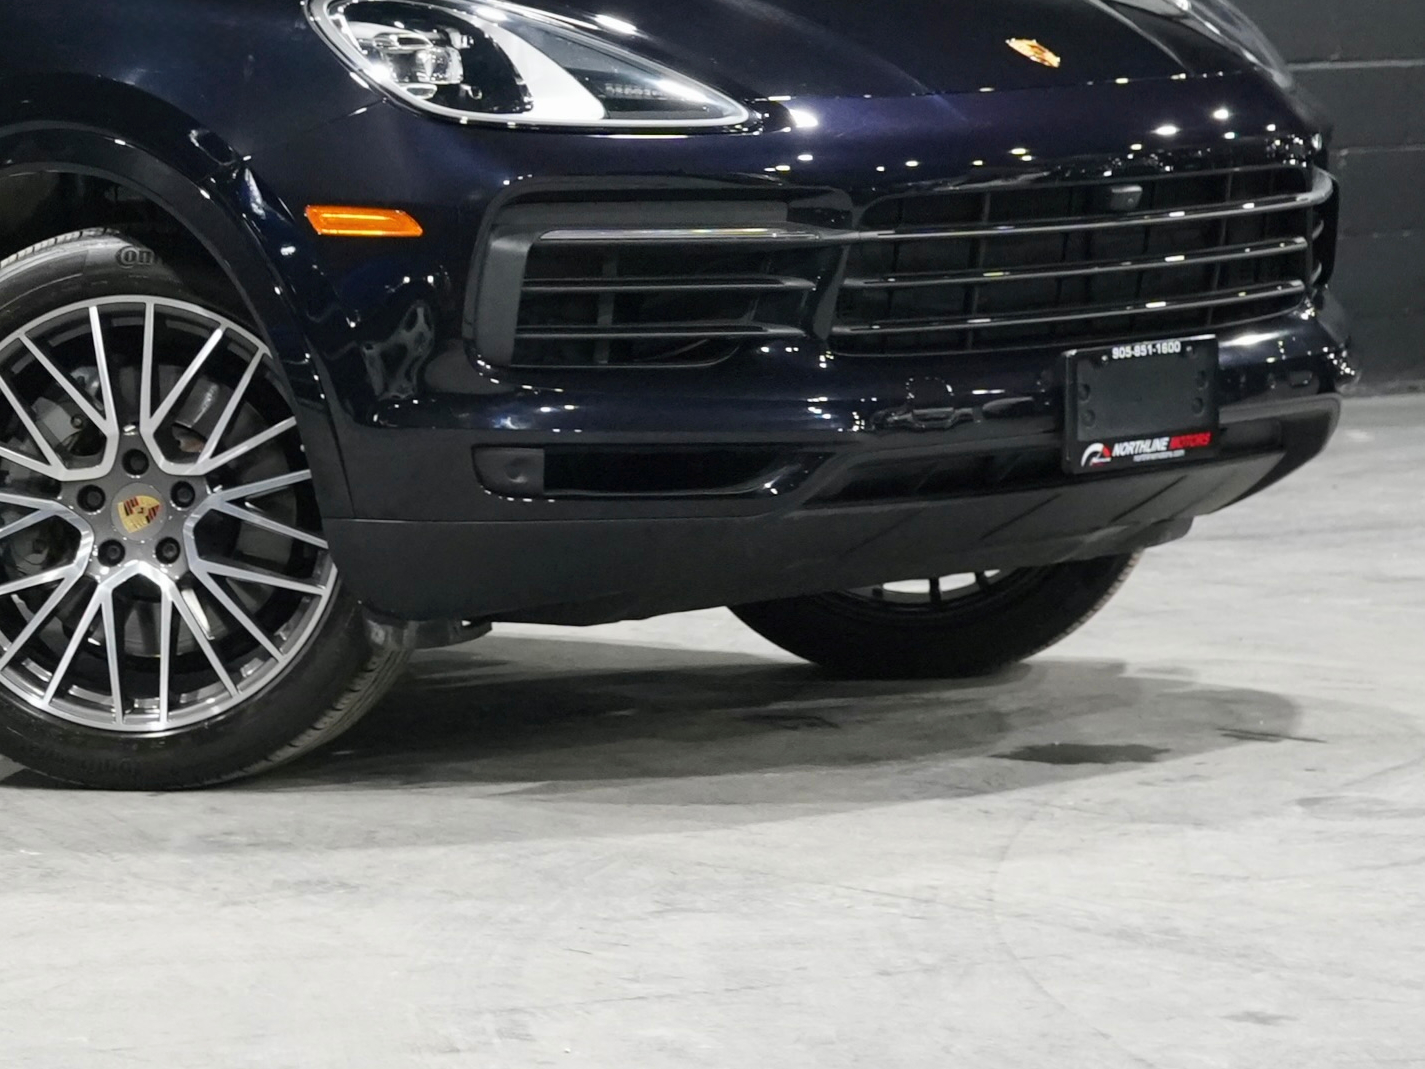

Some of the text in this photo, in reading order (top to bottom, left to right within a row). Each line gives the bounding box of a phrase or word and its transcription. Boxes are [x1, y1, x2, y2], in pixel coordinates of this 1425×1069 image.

[1112, 341, 1181, 359] 905-851-1600
[1112, 437, 1170, 457] NORTHLINE
[1169, 432, 1211, 450] MOTORS
